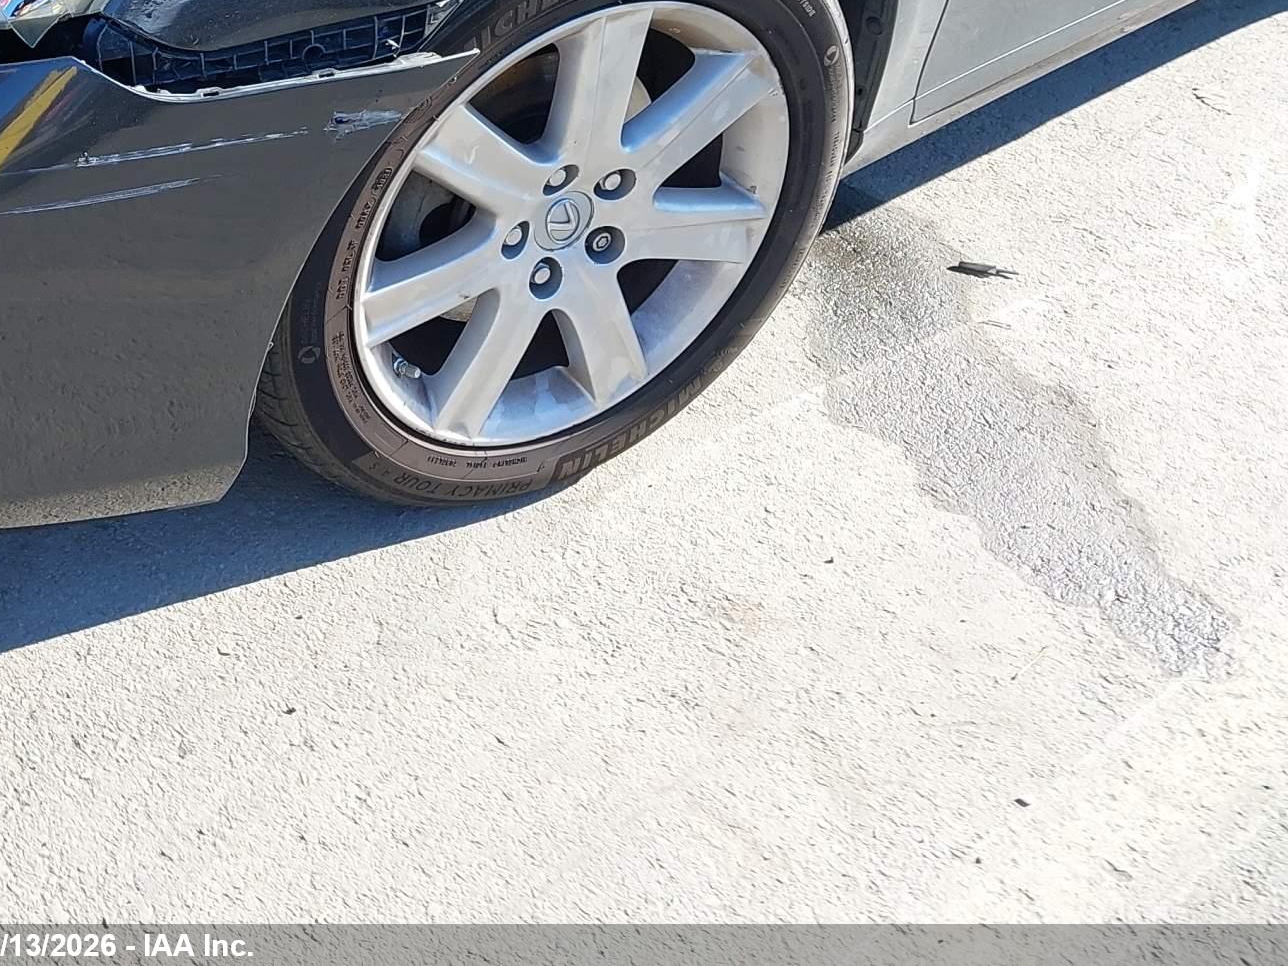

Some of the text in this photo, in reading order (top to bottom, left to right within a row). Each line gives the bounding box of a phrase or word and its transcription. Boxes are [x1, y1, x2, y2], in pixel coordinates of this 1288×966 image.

[559, 377, 703, 480] MICHELIN
[393, 472, 442, 495] TOUR
[445, 480, 534, 498] PRIMACY
